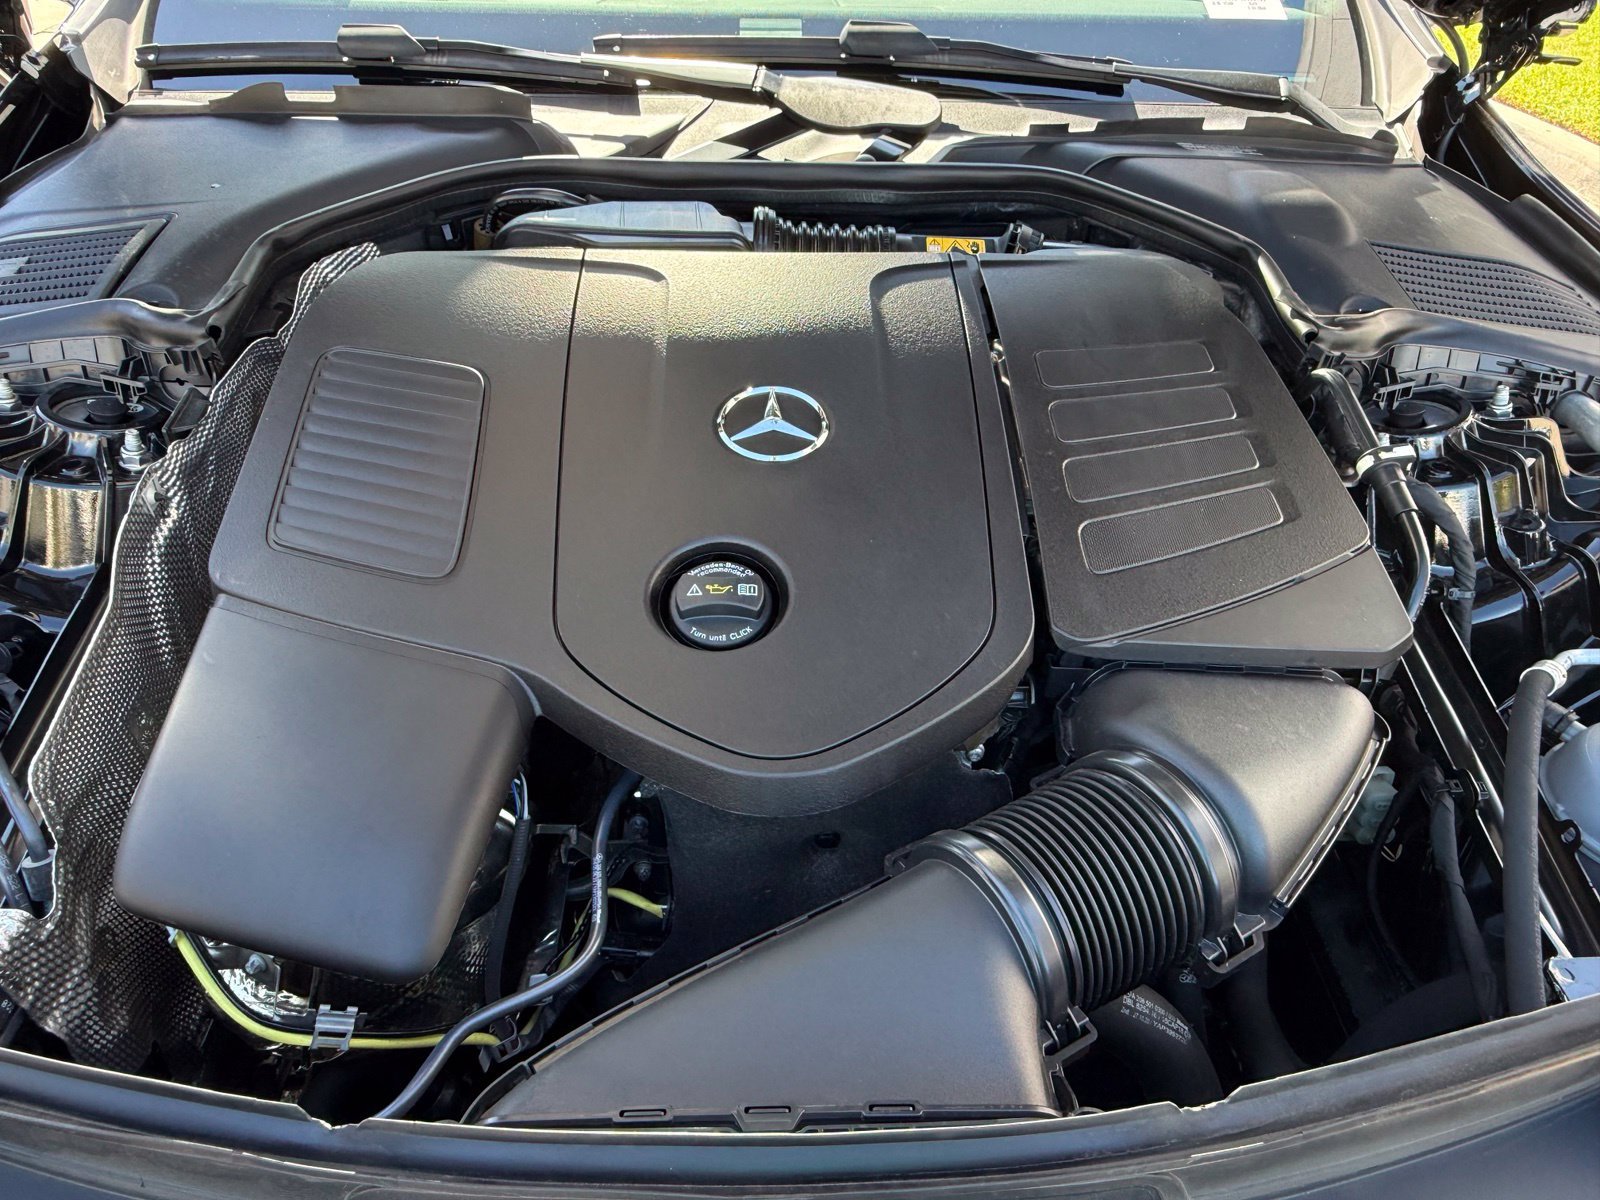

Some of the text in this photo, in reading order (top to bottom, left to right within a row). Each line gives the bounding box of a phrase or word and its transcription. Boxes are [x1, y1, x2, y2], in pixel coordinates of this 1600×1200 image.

[687, 562, 744, 576] Mercedes-Benz
[697, 567, 746, 577] recommended
[690, 627, 706, 640] Turn
[729, 626, 753, 641] CLICK
